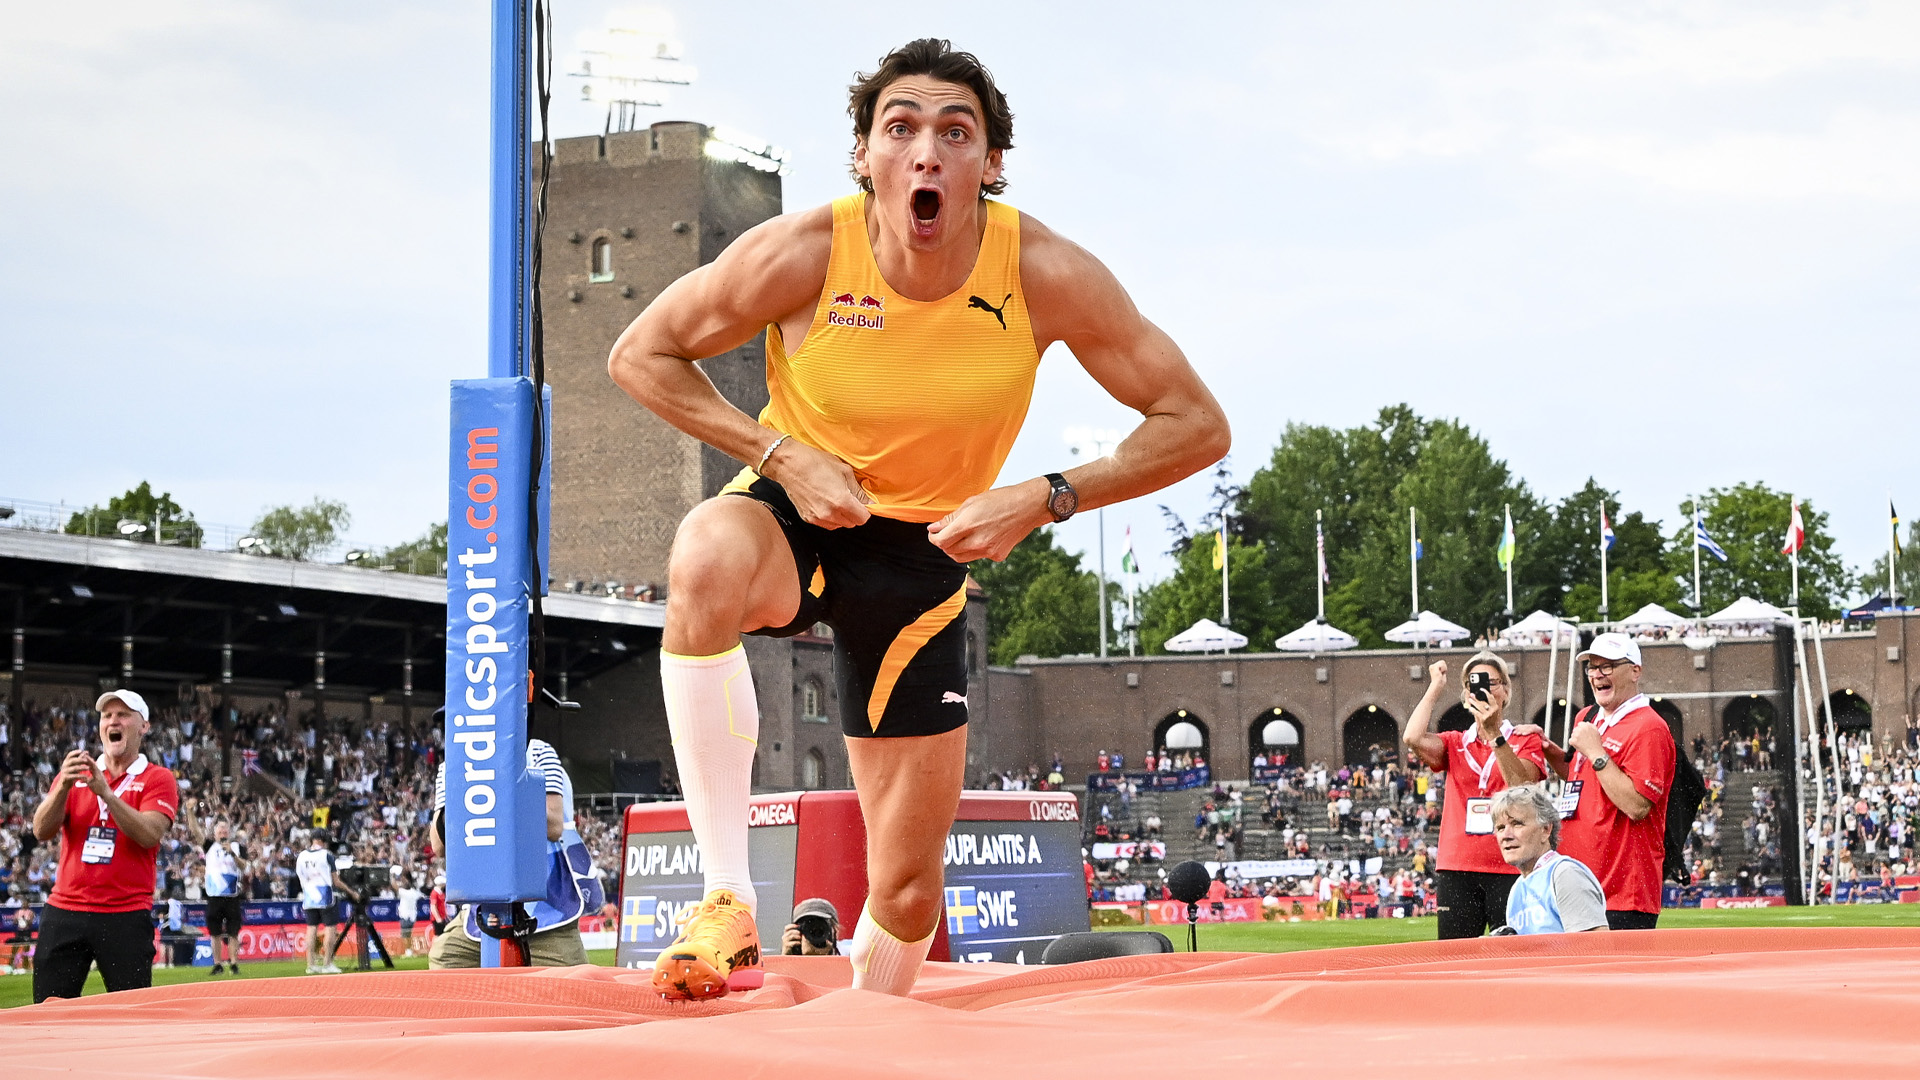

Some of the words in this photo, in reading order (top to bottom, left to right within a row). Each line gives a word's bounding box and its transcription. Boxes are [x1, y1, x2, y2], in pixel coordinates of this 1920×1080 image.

[828, 311, 855, 327] Red
[856, 315, 884, 329] Bull
[453, 426, 510, 848] nordicsport.com
[749, 803, 796, 827] OMEGA
[1042, 801, 1079, 821] OMEGA
[626, 843, 704, 877] DUPLANT
[943, 834, 1026, 866] DUPLANTIS
[1028, 834, 1042, 864] A
[655, 900, 701, 938] SW
[976, 891, 1019, 929] SWE
[259, 932, 306, 954] OMEG
